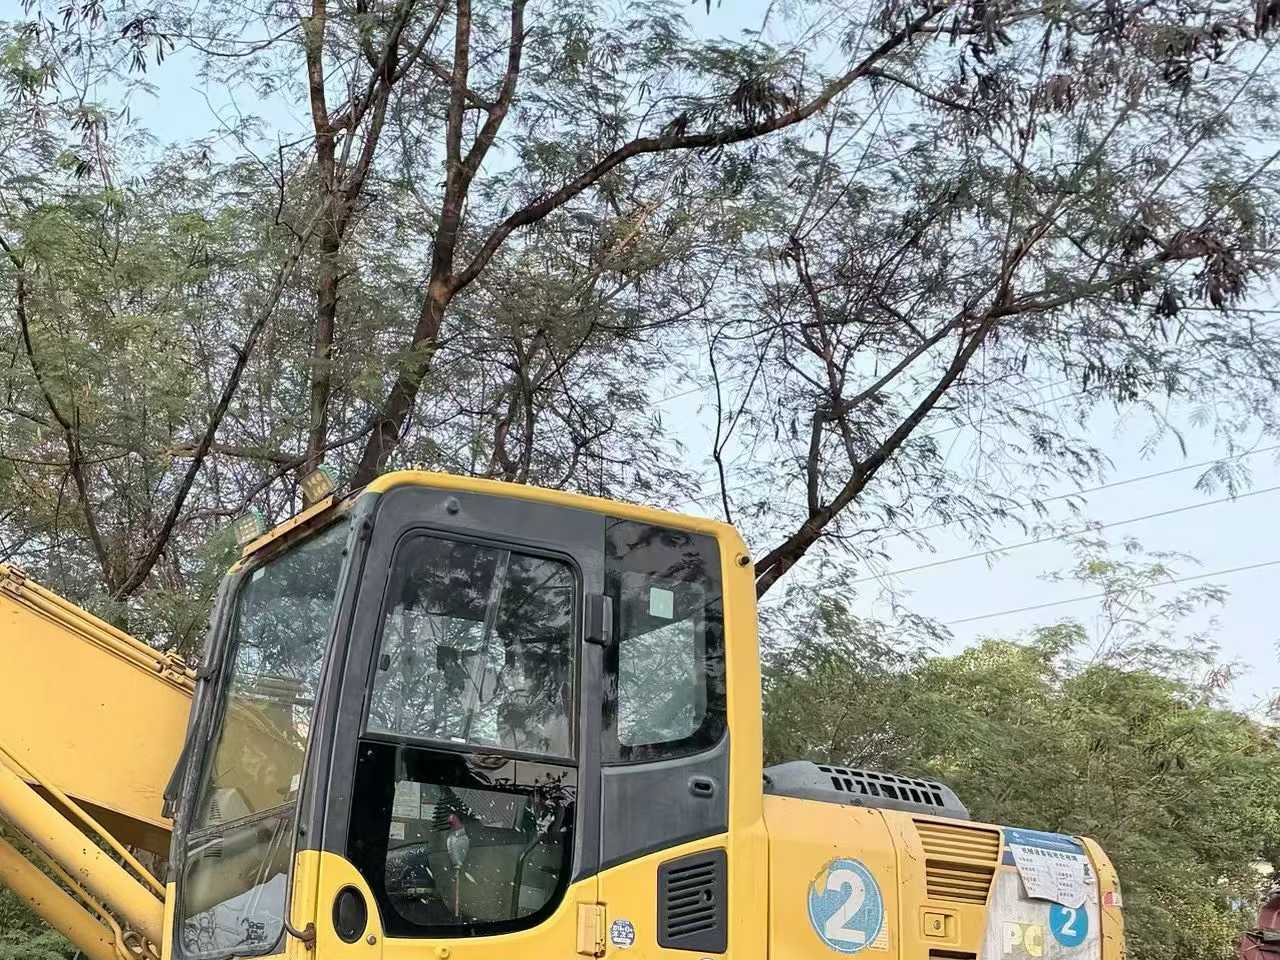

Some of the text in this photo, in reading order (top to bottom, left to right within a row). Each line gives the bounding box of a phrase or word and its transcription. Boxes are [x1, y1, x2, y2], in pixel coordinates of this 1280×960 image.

[825, 868, 866, 945] 2
[1060, 906, 1078, 937] 2
[1004, 922, 1044, 957] PC
